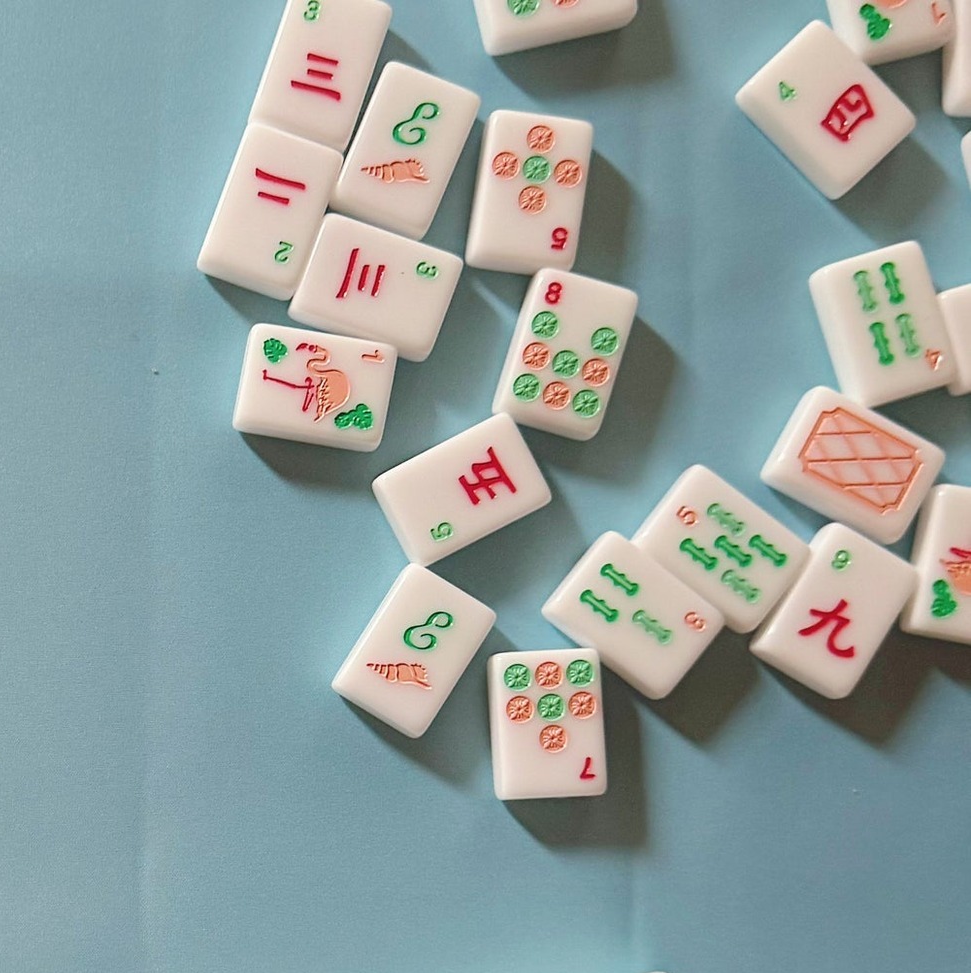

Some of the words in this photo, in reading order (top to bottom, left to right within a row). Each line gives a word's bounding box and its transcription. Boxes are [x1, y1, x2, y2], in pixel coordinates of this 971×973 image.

[291, 53, 341, 102] 三
[820, 84, 875, 143] 四
[255, 168, 307, 206] 二
[274, 241, 293, 263] 2
[551, 227, 569, 251] 5
[416, 262, 438, 278] 3
[544, 282, 563, 305] 8
[458, 446, 517, 506] 五
[430, 522, 453, 541] 5
[798, 599, 856, 659] 九
